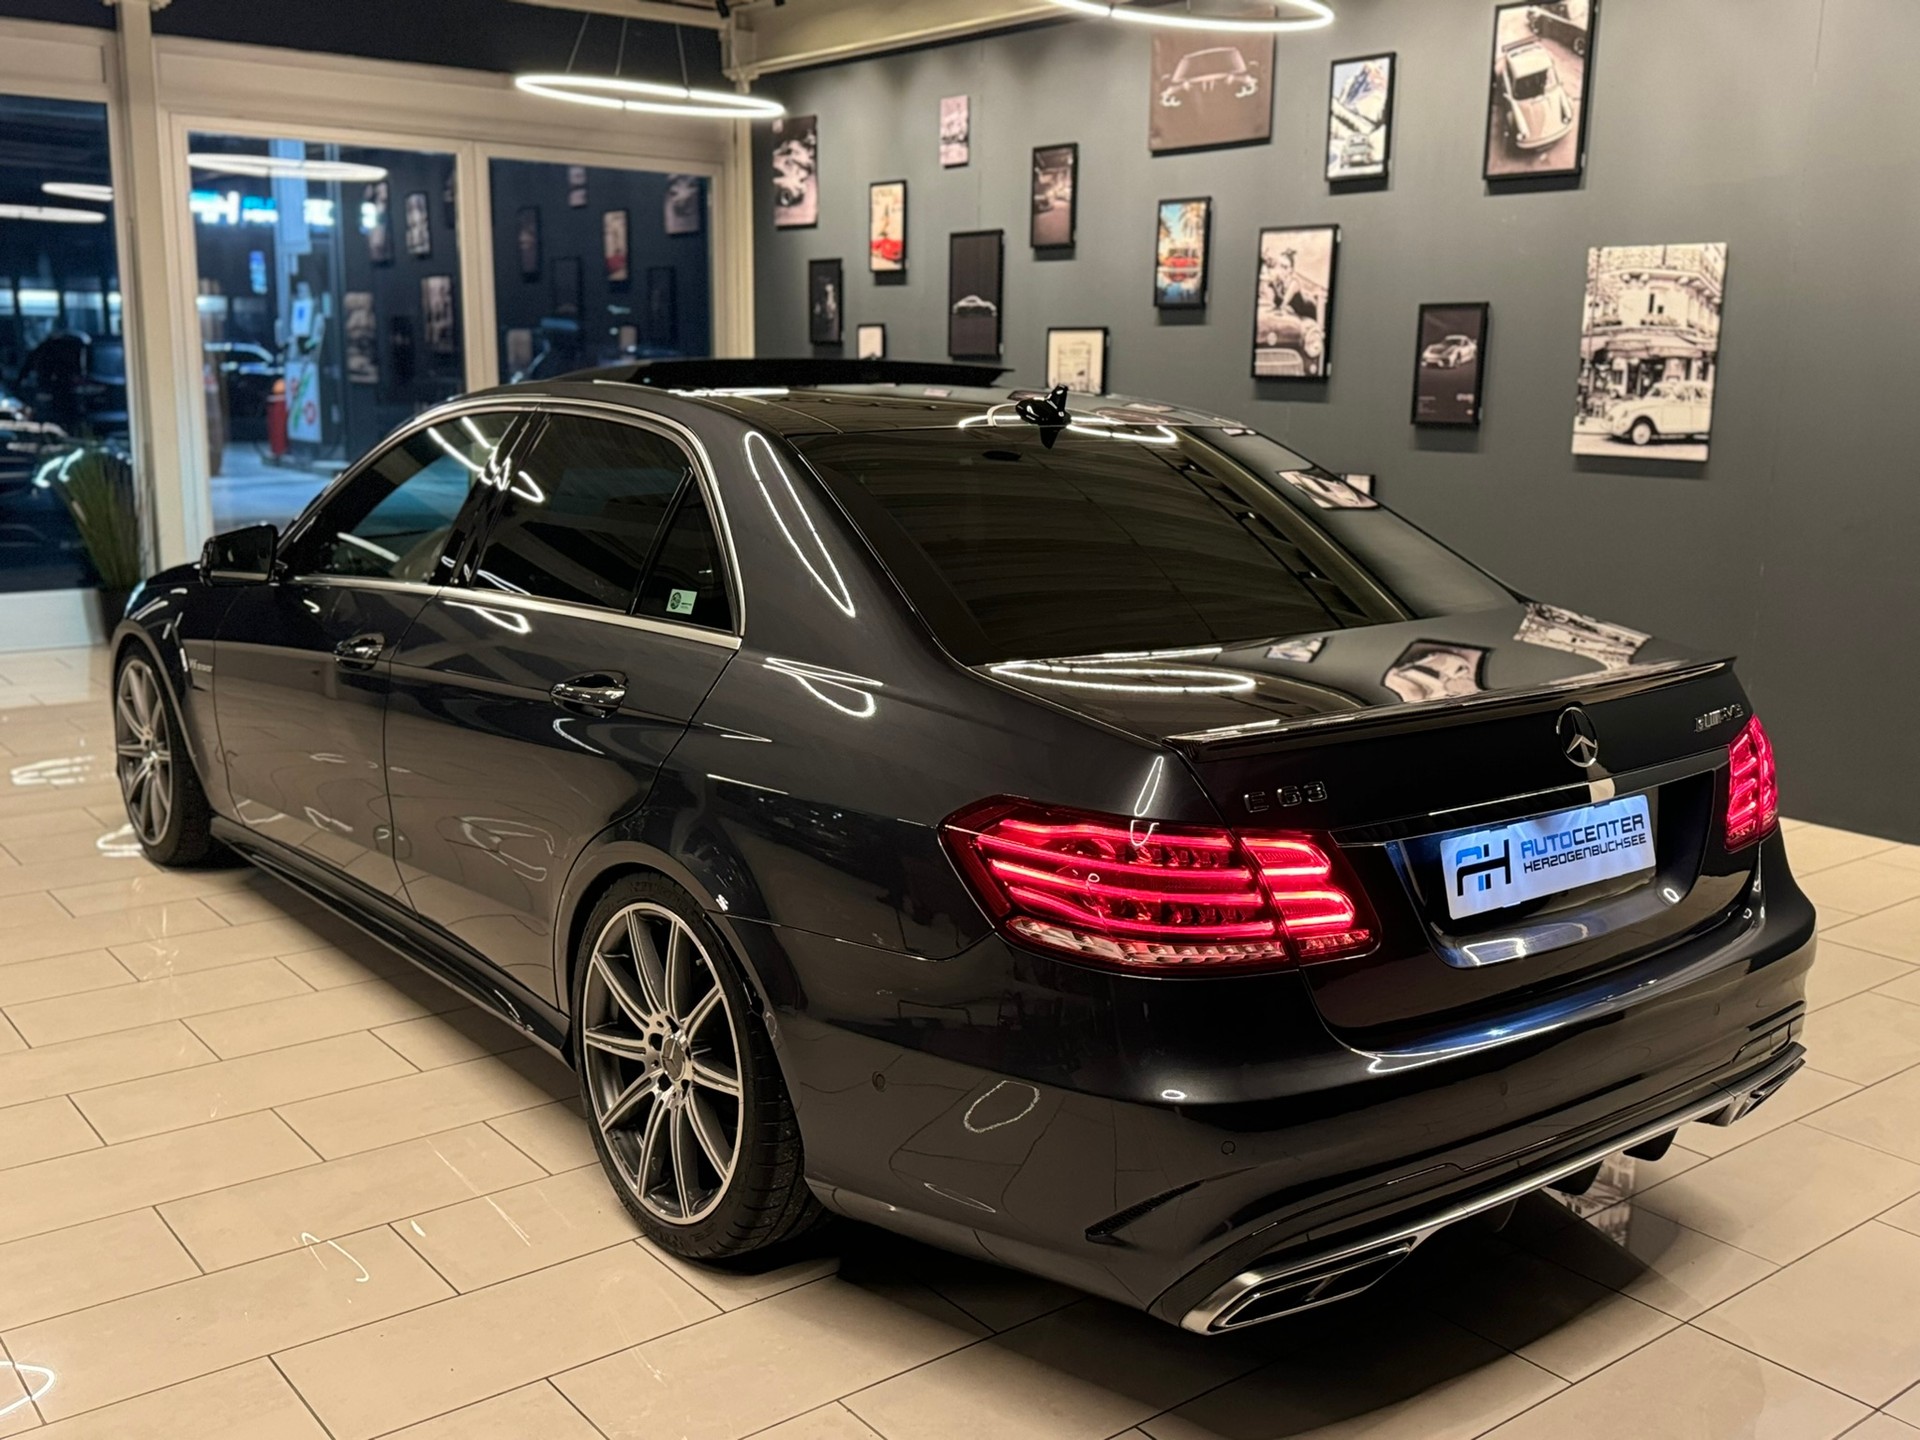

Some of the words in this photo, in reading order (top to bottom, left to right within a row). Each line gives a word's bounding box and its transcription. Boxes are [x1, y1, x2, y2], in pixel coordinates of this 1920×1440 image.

[1243, 791, 1270, 814] E
[1277, 781, 1328, 808] 63
[1520, 813, 1645, 860] AUTOCENTER
[1523, 833, 1647, 874] HERZOGENBUCHSEE
